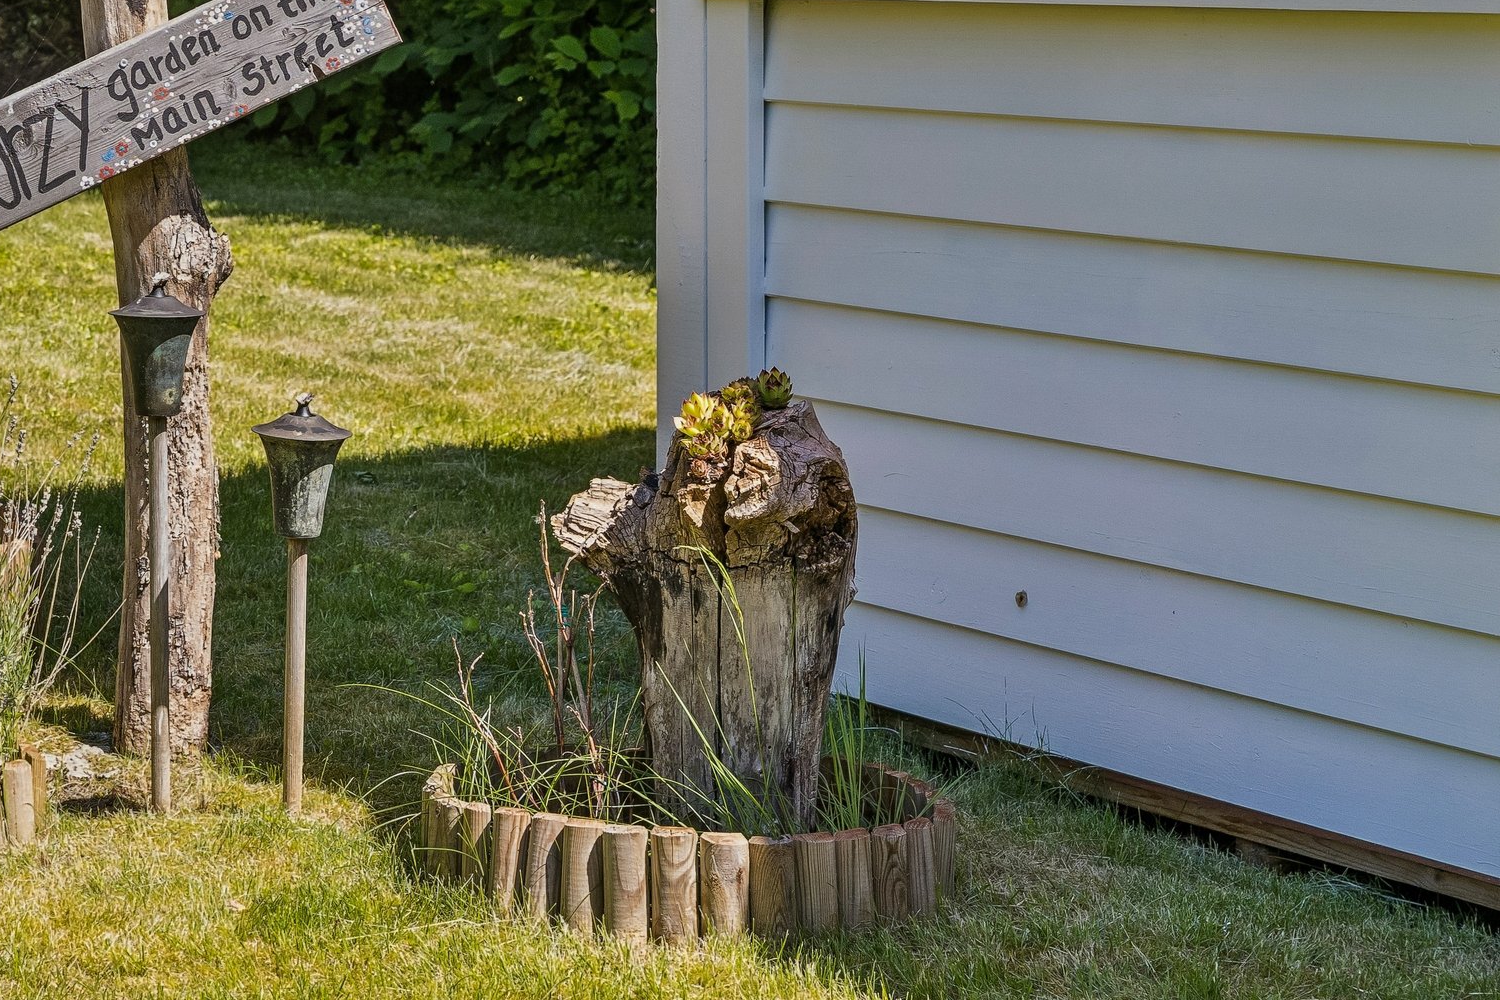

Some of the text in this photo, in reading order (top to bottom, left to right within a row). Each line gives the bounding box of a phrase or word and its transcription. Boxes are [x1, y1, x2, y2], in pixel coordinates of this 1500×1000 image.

[107, 29, 222, 123] garden
[231, 4, 274, 41] on
[130, 14, 355, 151] Main Street
